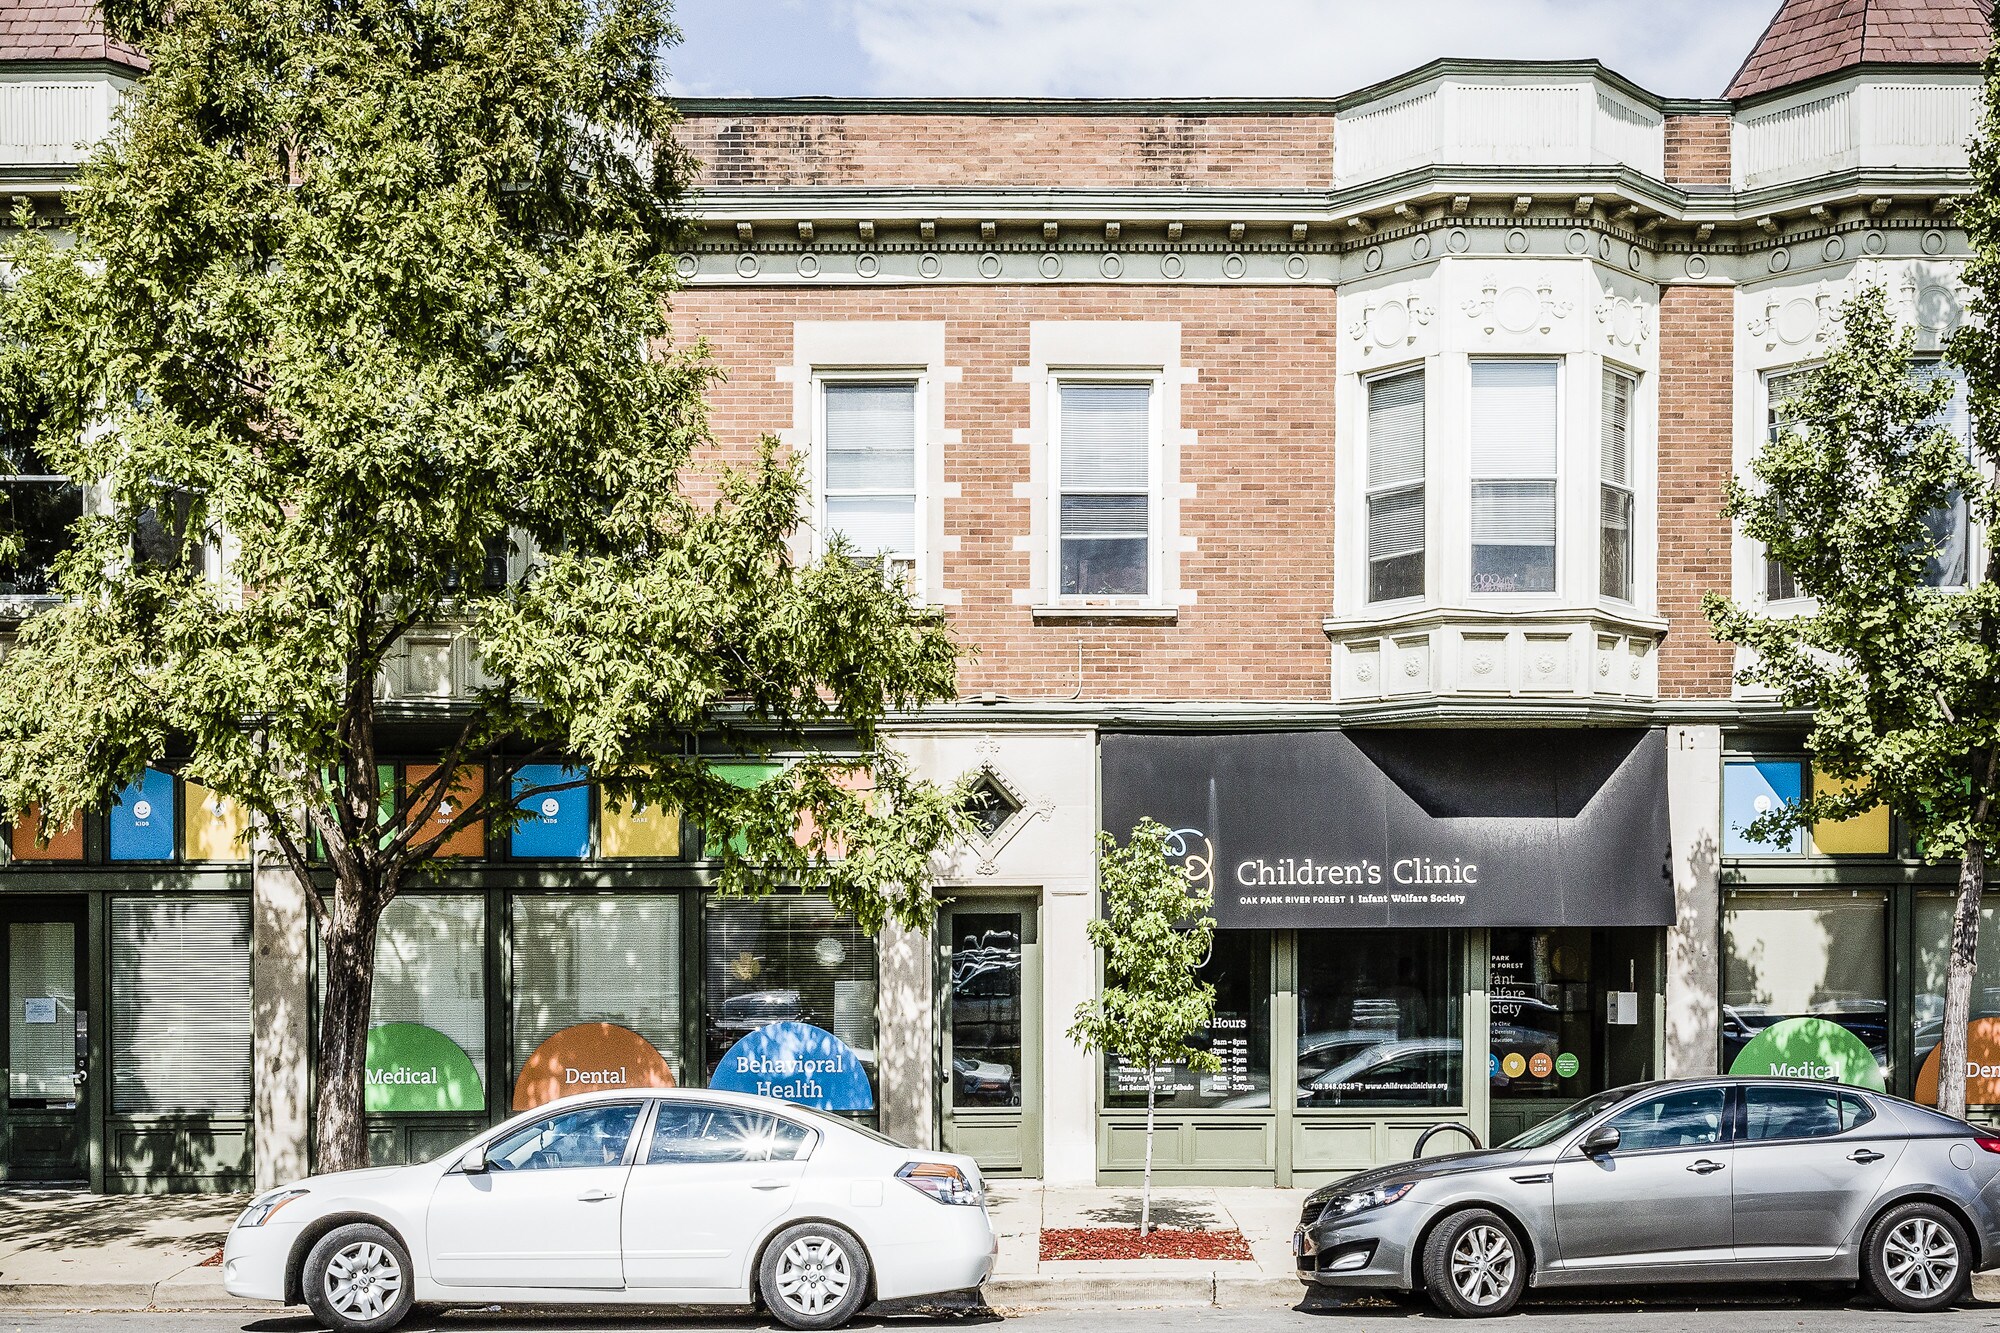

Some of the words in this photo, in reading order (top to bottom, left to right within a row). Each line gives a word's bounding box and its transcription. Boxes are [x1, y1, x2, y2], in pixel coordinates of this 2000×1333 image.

[1237, 859, 1382, 886] Children's
[1393, 857, 1478, 885] Clinic
[1240, 896, 1258, 905] OAK
[1260, 896, 1283, 904] PARK
[1285, 895, 1311, 904] RIVER
[1313, 895, 1346, 904] FOREST
[1358, 894, 1388, 904] Infant
[1391, 894, 1428, 903] Welfare
[1430, 893, 1466, 905] Society
[1490, 972, 1515, 985] fant
[1490, 986, 1525, 998] elfare
[1491, 1001, 1522, 1017] ciety
[1212, 1018, 1247, 1028] Hours
[736, 1055, 843, 1073] Behavioral
[1770, 1062, 1840, 1079] Medical
[365, 1067, 438, 1085] Medical
[565, 1067, 627, 1084] Dental
[1118, 1075, 1138, 1083] Friday
[756, 1080, 823, 1098] Health
[1129, 1084, 1157, 1093] Saturdy
[1310, 1083, 1355, 1091] 708.848.0528
